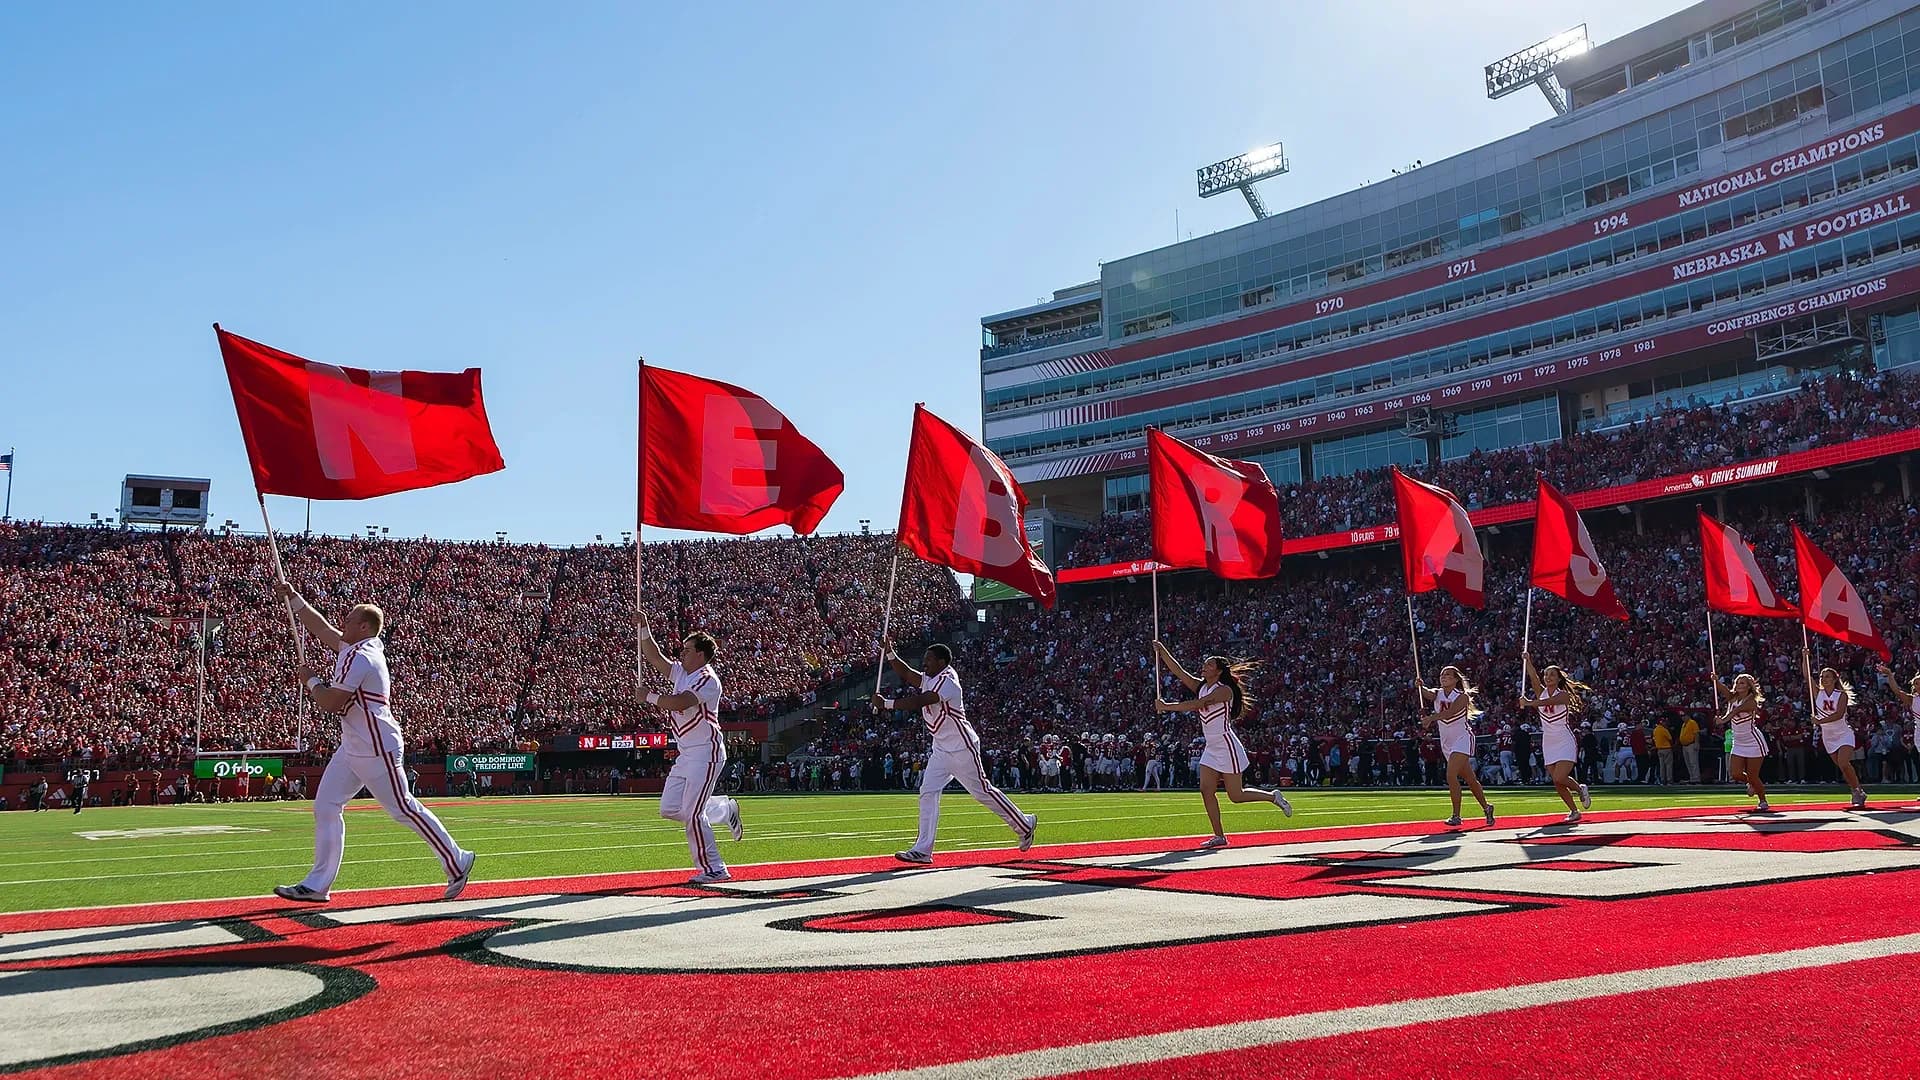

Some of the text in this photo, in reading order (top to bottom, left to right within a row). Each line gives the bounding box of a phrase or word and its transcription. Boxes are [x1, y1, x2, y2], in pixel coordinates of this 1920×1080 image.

[1314, 123, 1885, 315] 1970 1971 1994 NATIONAL CHAMPIONS
[1673, 195, 1911, 280] NEBRASKA N FOOTBALL
[1120, 450, 1136, 460] 1928
[1193, 437, 1211, 447] 1932
[1220, 432, 1238, 443] 1933
[1246, 427, 1264, 438] 1935
[1272, 421, 1291, 433] 1936
[1298, 416, 1317, 428] 1937
[1326, 410, 1346, 422] 1940
[1353, 405, 1374, 416] 1963
[1384, 399, 1404, 410] 1964
[1412, 393, 1431, 404] 1966
[1441, 386, 1462, 398] 1969
[1471, 378, 1492, 391] 1970
[1502, 372, 1523, 384] 1971
[1534, 364, 1556, 377] 1972
[1566, 356, 1589, 370] 1975
[1599, 348, 1622, 362] 1978
[1633, 340, 1656, 353] 1981
[1707, 302, 1796, 335] CONFERENCE
[1797, 278, 1888, 312] CHAMPIONS
[305, 362, 418, 480] N
[700, 394, 784, 515] E
[952, 444, 1026, 568] B
[1190, 462, 1245, 562] R
[1664, 460, 1779, 493] Ameritas DRIVE SUMMARY
[1351, 531, 1358, 543] 10
[1359, 531, 1375, 542] PLAYS
[1423, 498, 1484, 592] A
[1808, 566, 1873, 638] A
[584, 737, 595, 748] N
[598, 737, 608, 747] 14
[639, 736, 648, 745] 16
[653, 735, 661, 745] M
[1822, 700, 1835, 711] N
[472, 755, 527, 764] OLD DOMINION
[475, 762, 524, 771] FREIGHT LINE
